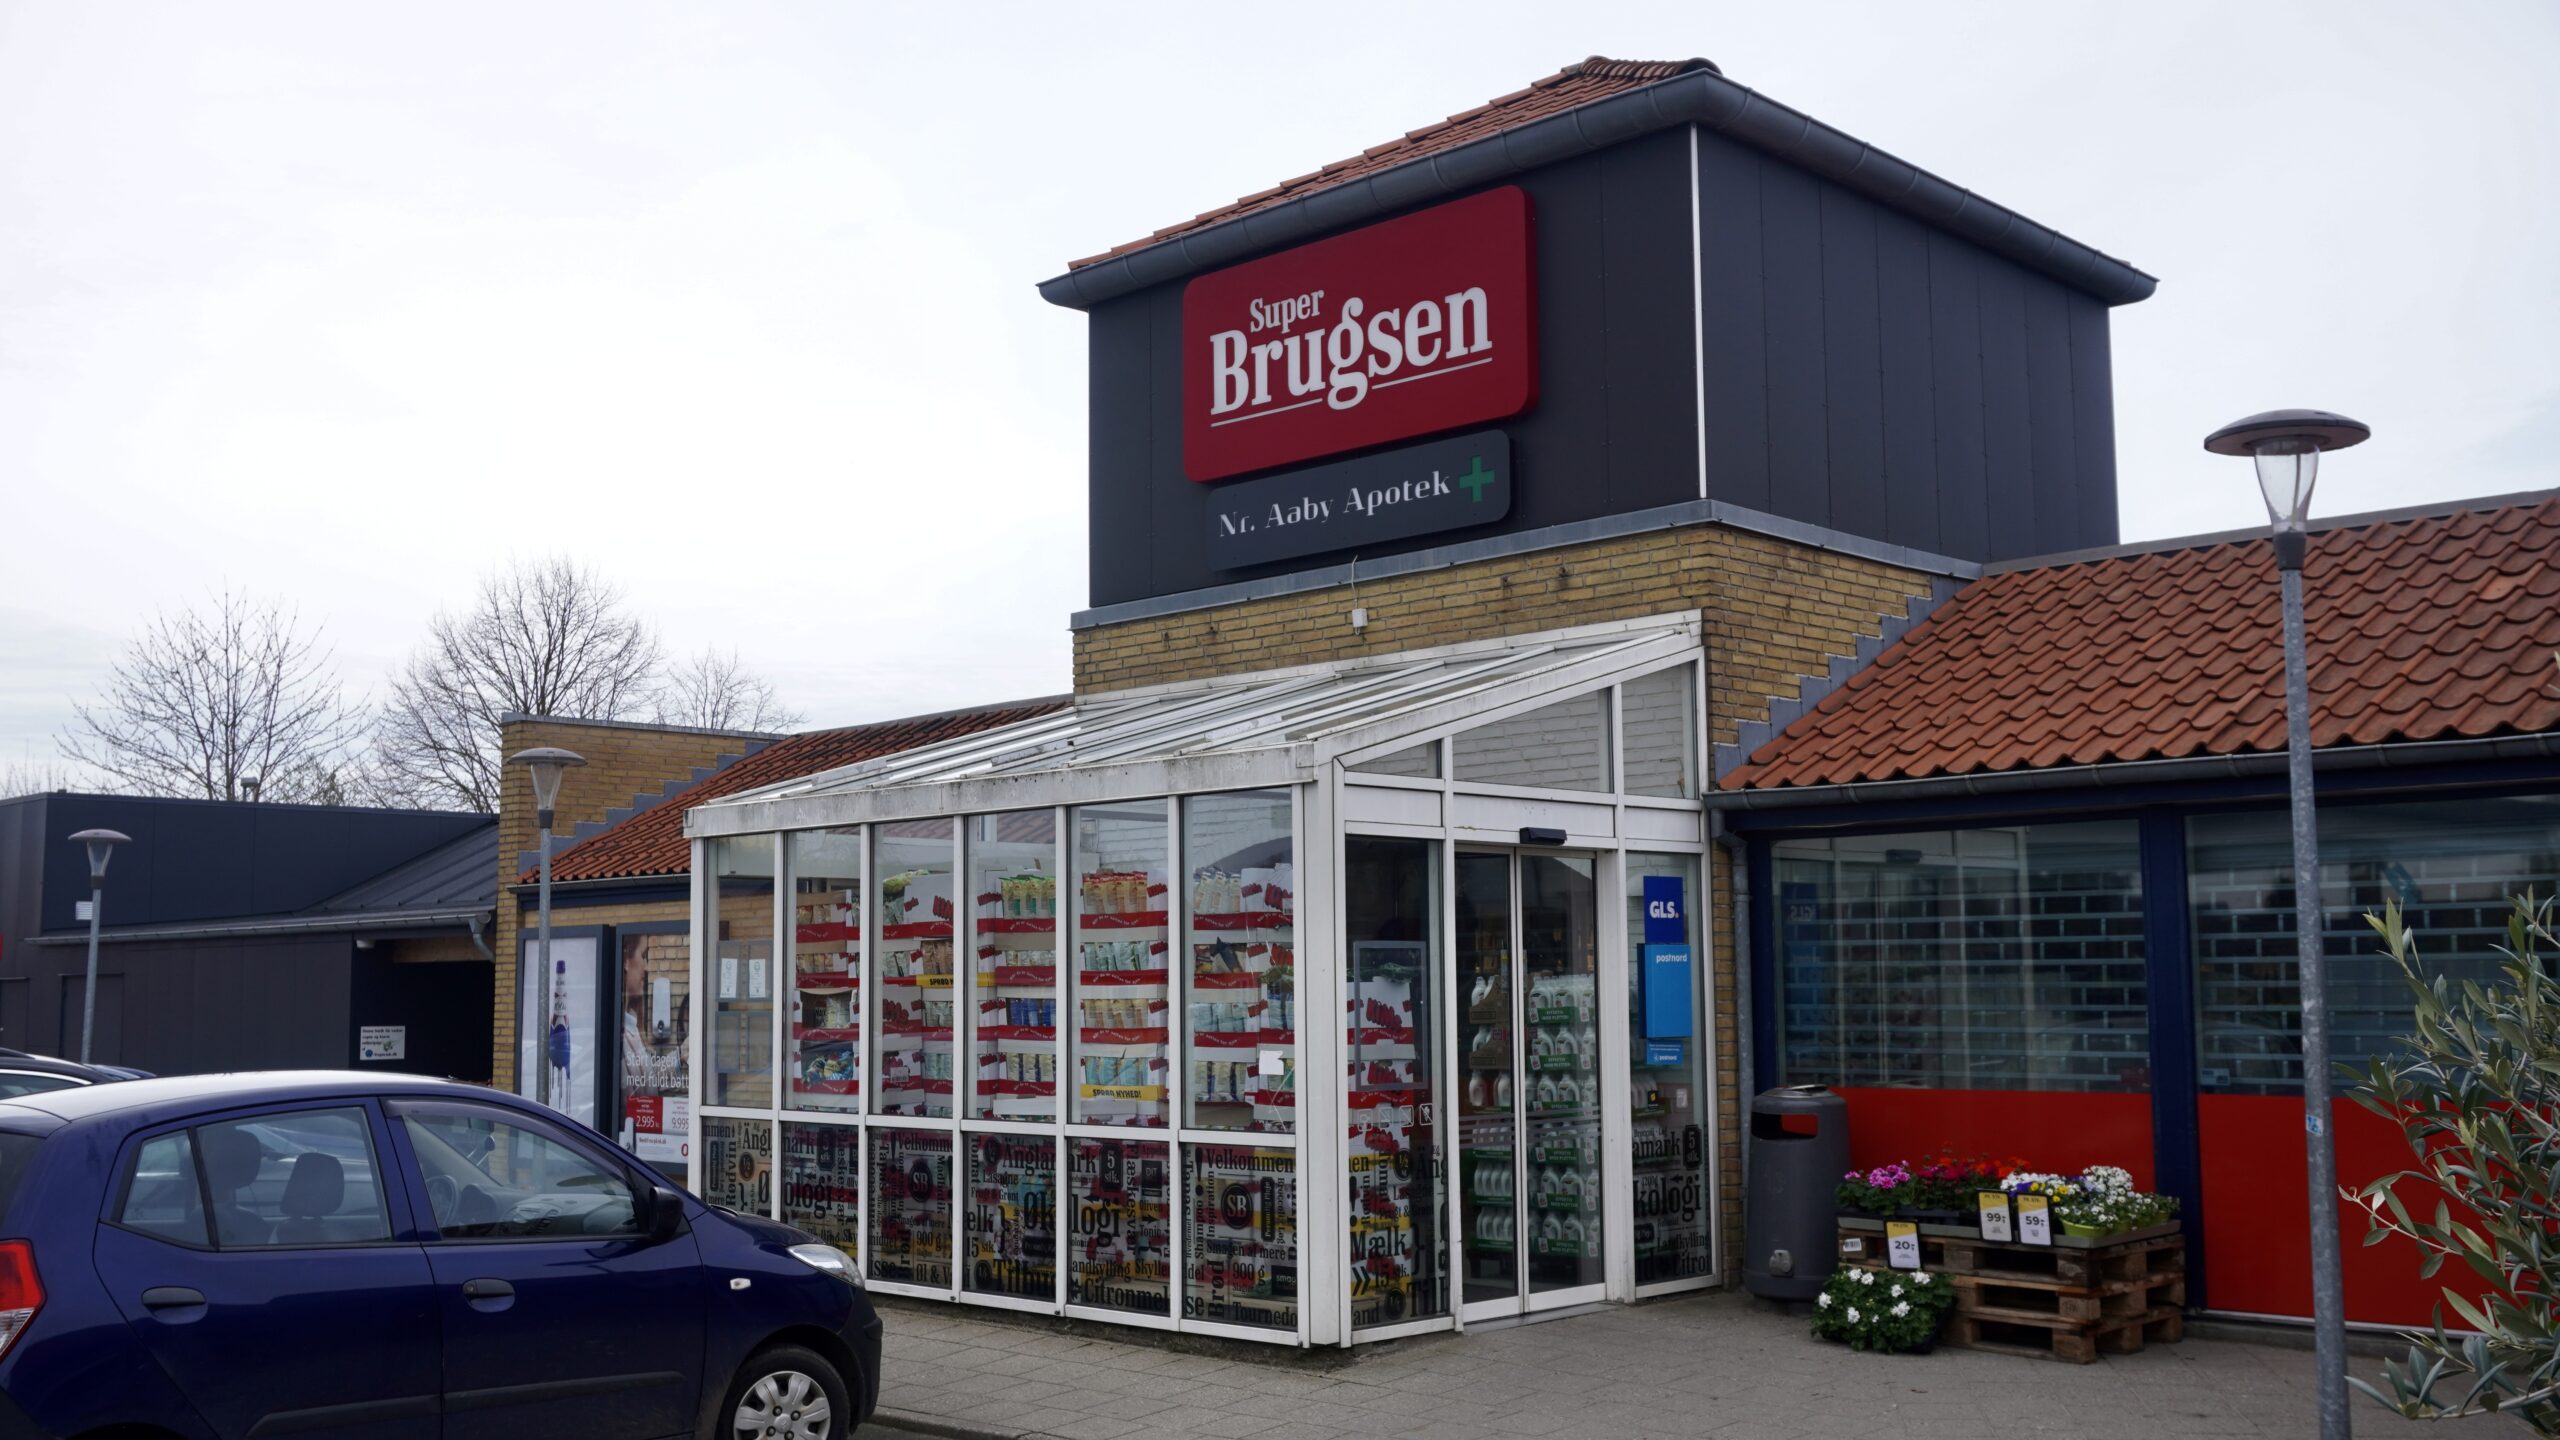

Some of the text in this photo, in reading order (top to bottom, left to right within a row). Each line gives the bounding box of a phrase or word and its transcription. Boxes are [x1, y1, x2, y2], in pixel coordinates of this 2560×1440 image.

[1250, 289, 1325, 334] Super
[1210, 286, 1493, 411] Brugsen
[1219, 470, 1451, 538] Nr. Aaby Apotek
[1656, 953, 1688, 964] postnord
[626, 1050, 677, 1072] Start dagen
[626, 1072, 646, 1087] med
[648, 1071, 668, 1089] fuldt
[1115, 1090, 1142, 1099] NYHED!
[635, 1115, 655, 1128] 2.995
[1688, 1130, 1696, 1151] 5
[1106, 1151, 1116, 1169] 5
[1206, 1148, 1296, 1175] Velkommen
[725, 1140, 737, 1206] Rødvin
[912, 1171, 929, 1194] SB
[1104, 1170, 1120, 1184] stk.
[1145, 1166, 1158, 1178] DIT
[1139, 1198, 1163, 1213] Oliven
[1206, 1170, 1216, 1239] Inspiration
[1227, 1194, 1247, 1218] SB
[916, 1231, 933, 1247] 900
[1139, 1224, 1163, 1238] Tonic
[1194, 1199, 1205, 1260] Shampoo
[967, 1236, 980, 1259] 15
[1260, 1247, 1286, 1259] mere
[1350, 1225, 1408, 1262] Mælk
[1232, 1262, 1266, 1286] 900 g
[1207, 1260, 1225, 1317] Brød
